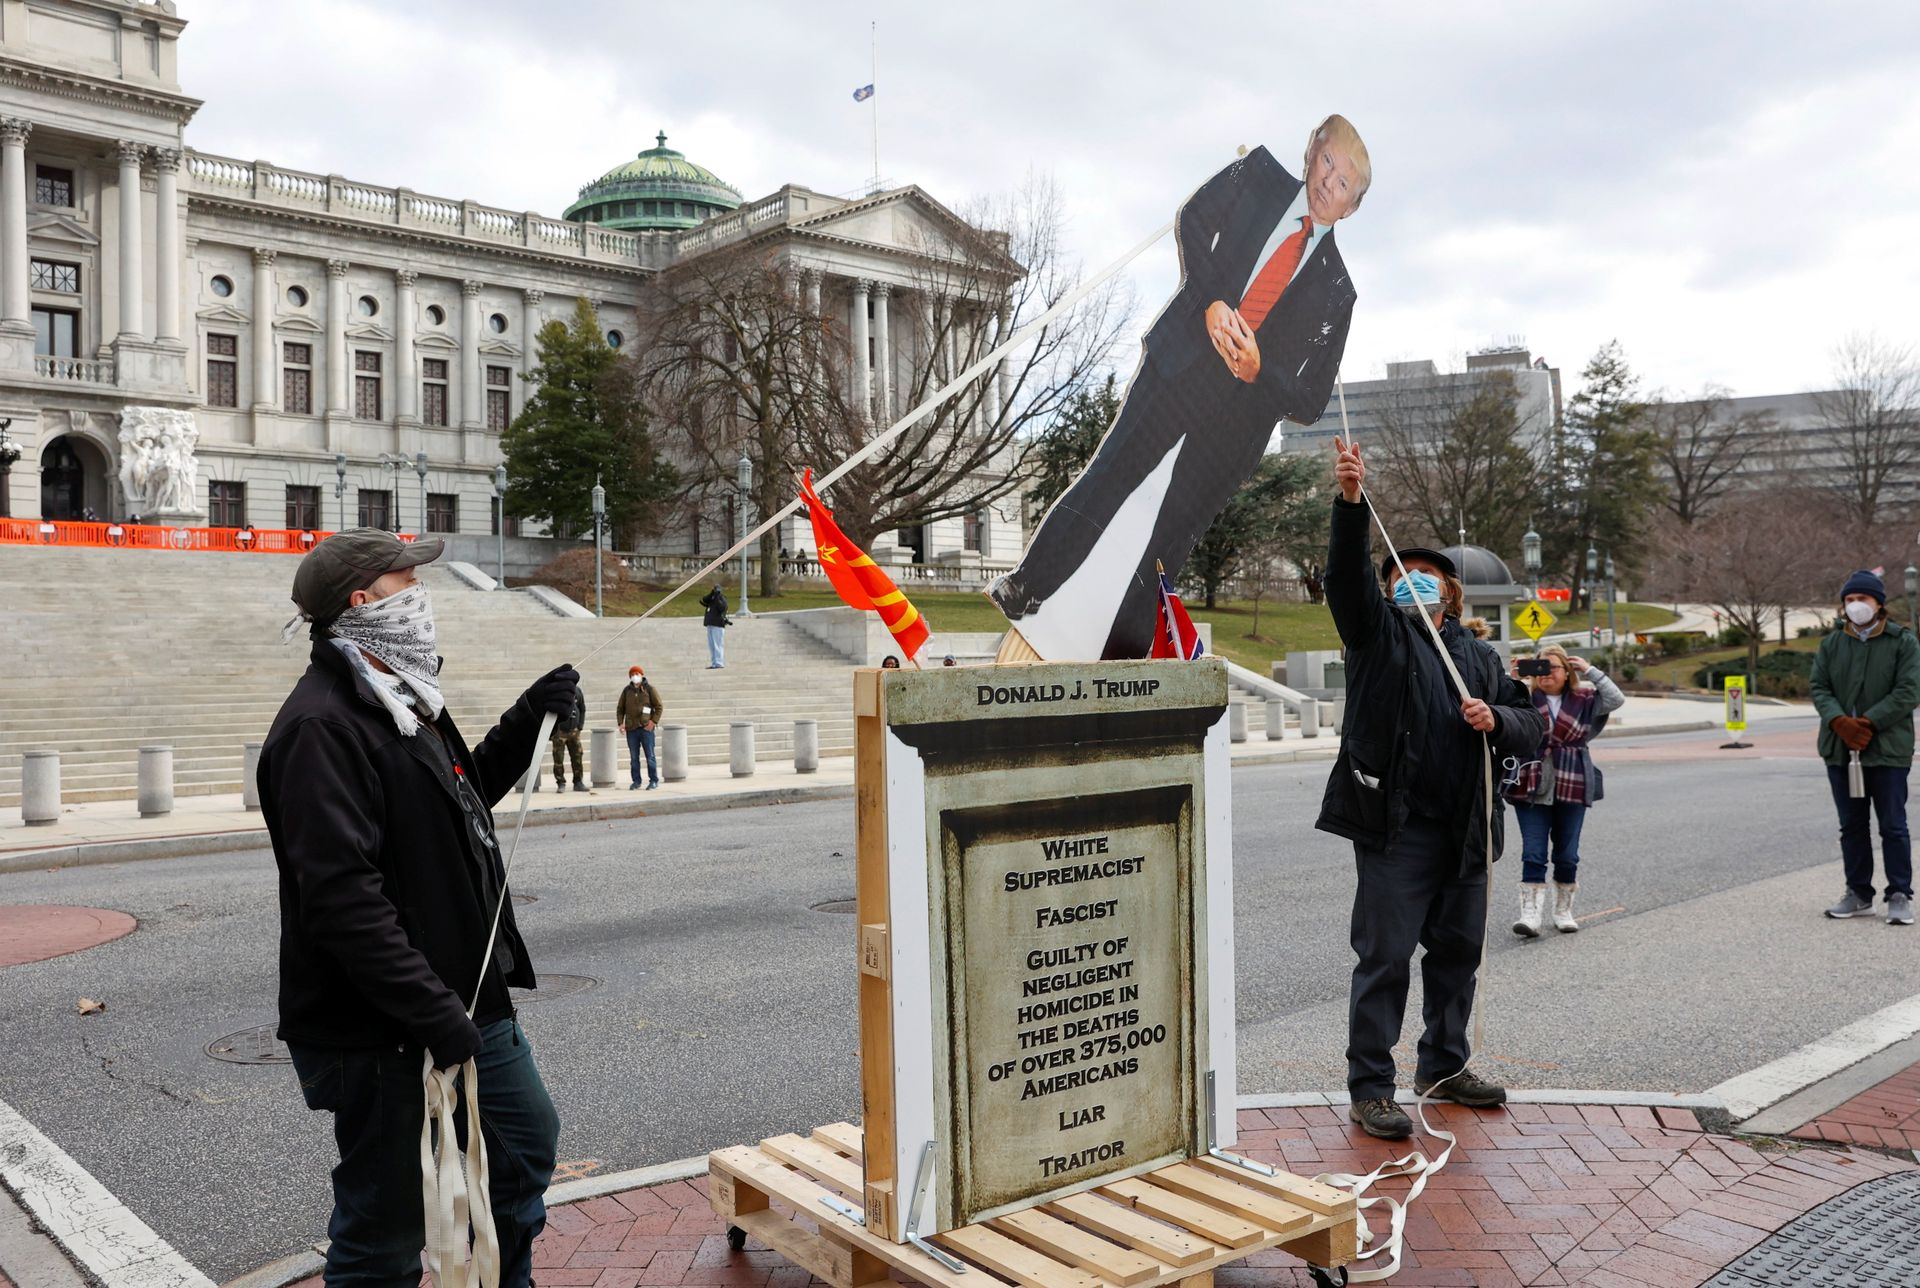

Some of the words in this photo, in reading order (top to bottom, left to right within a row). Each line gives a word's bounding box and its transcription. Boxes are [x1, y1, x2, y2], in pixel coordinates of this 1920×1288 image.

[977, 680, 1065, 706] DONALD
[1069, 680, 1087, 700] J.
[1093, 679, 1160, 698] TRUMP
[1041, 836, 1109, 861] WHITE
[1004, 856, 1145, 892] SUPREMACIST
[1036, 899, 1118, 928] FASCIST
[1027, 943, 1098, 971] GUILTY
[1103, 936, 1129, 956] OF
[1022, 960, 1134, 998] NEGLIGENT
[1017, 988, 1115, 1025] HOMICIDE
[1120, 984, 1139, 1003] IN
[1017, 1025, 1059, 1050] THE
[1063, 1008, 1140, 1042] DEATHS
[988, 1060, 1017, 1083] OF
[1021, 1047, 1076, 1075] OVER
[1079, 1023, 1167, 1061] 375,000
[1021, 1057, 1139, 1101] AMERICANS
[1059, 1104, 1106, 1132] LIAR
[1039, 1140, 1126, 1178] TRAITOR
